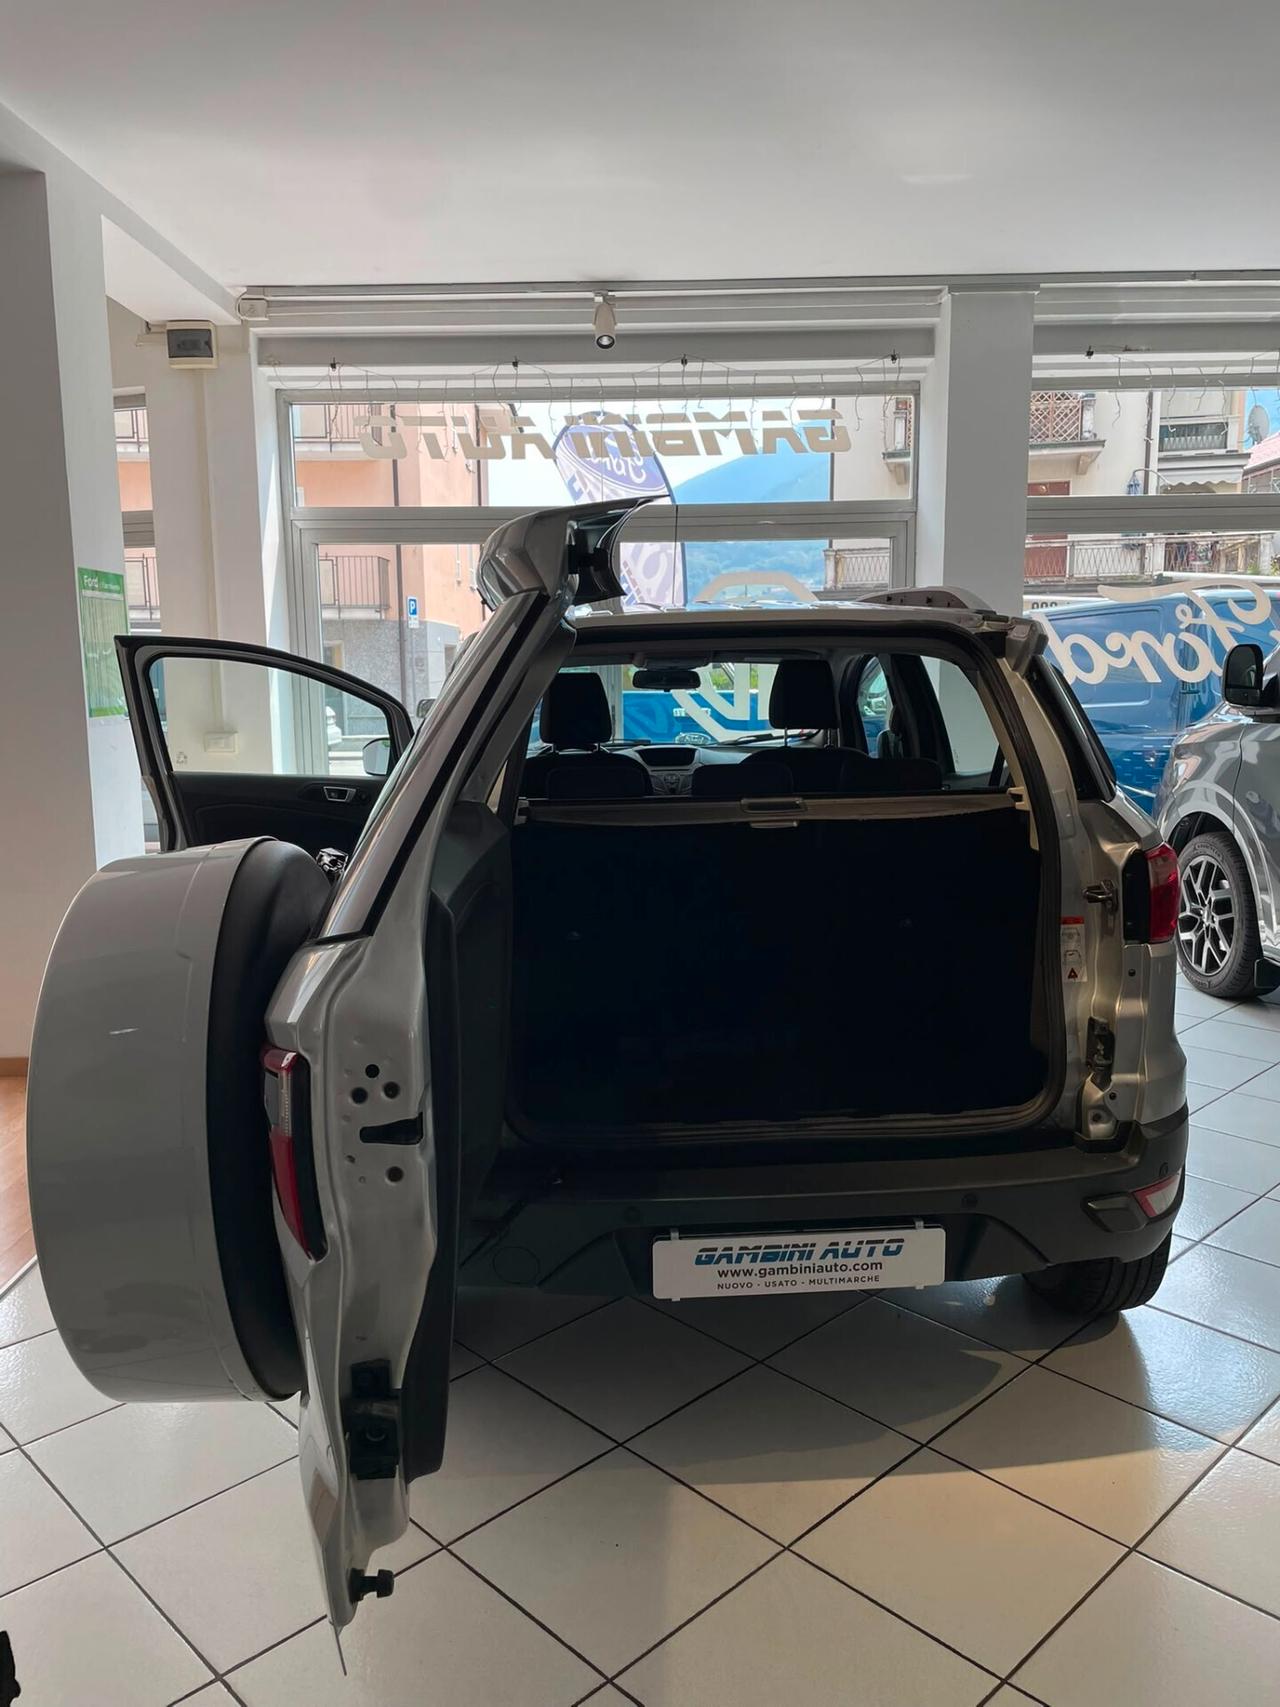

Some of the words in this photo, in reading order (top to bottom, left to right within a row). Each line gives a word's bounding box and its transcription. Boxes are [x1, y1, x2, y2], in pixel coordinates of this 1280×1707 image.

[410, 600, 417, 614] P
[694, 1243, 816, 1266] GAMBINI
[819, 1238, 905, 1260] AUTO
[717, 1261, 883, 1278] www.gambiniauto.com
[717, 1281, 753, 1290] NUOVO
[764, 1279, 798, 1288] USATO
[808, 1274, 880, 1286] MULTIMARCHE
